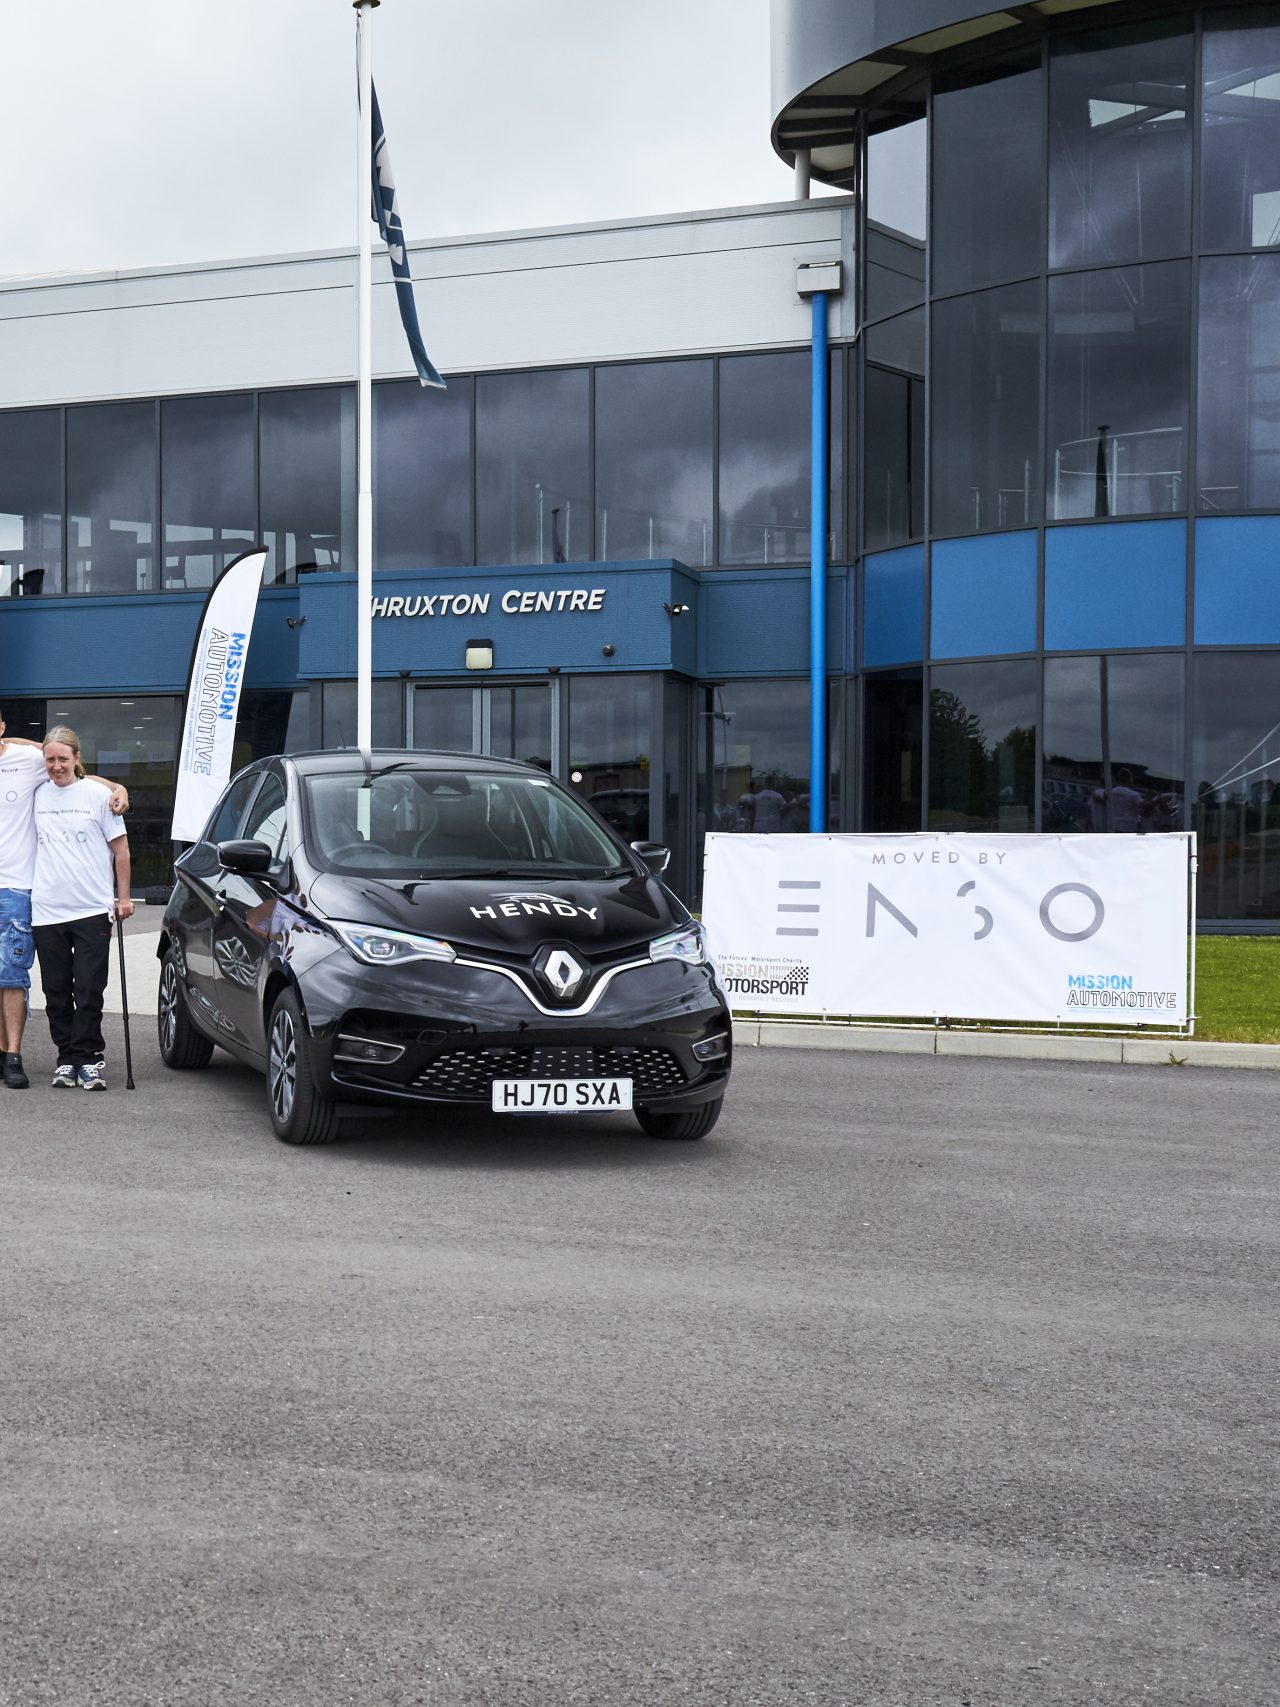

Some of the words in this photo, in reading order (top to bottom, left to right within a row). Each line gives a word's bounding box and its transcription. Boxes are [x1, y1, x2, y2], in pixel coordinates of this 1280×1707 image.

[371, 592, 490, 618] HRUXTON
[501, 589, 606, 614] CENTRE
[218, 632, 246, 720] MISSION
[193, 627, 229, 776] AUTOMOTIVE
[872, 852, 960, 865] MOVED
[979, 851, 1006, 865] BY
[470, 902, 598, 920] HENDY
[775, 880, 1105, 943] ENSO
[720, 963, 769, 980] ISSION
[724, 977, 809, 996] OTORSPORT
[1068, 974, 1133, 990] MISSION
[1066, 989, 1177, 1009] AUTOMOTIVE
[503, 1083, 568, 1106] HJ70
[575, 1081, 621, 1105] SXA
